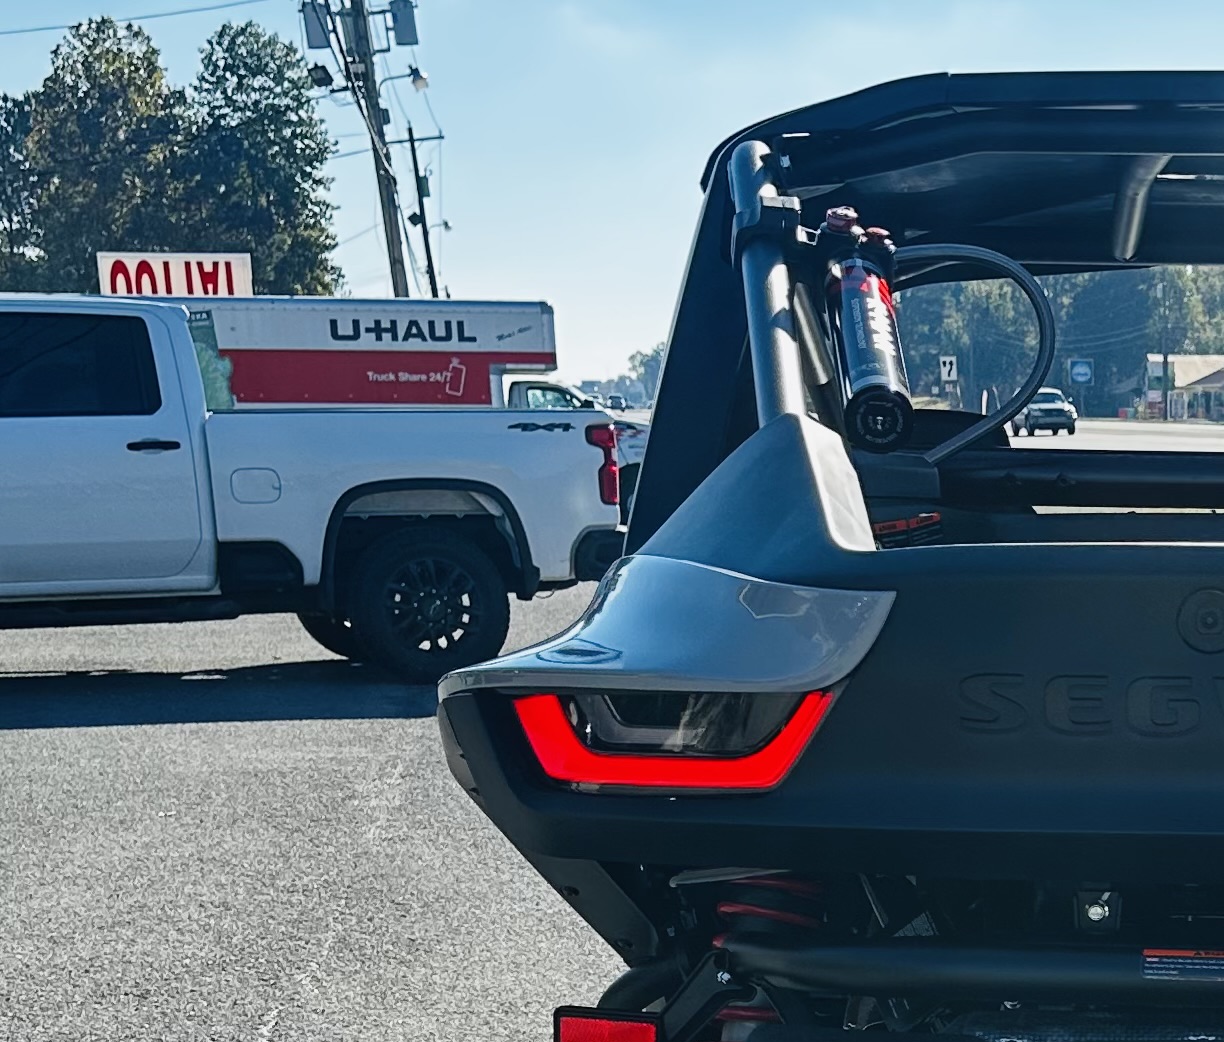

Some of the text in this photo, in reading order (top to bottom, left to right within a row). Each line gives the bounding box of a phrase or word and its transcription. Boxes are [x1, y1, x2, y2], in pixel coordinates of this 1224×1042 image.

[329, 318, 477, 343] U-HAUL
[366, 371, 453, 383] Truck Share 24/7
